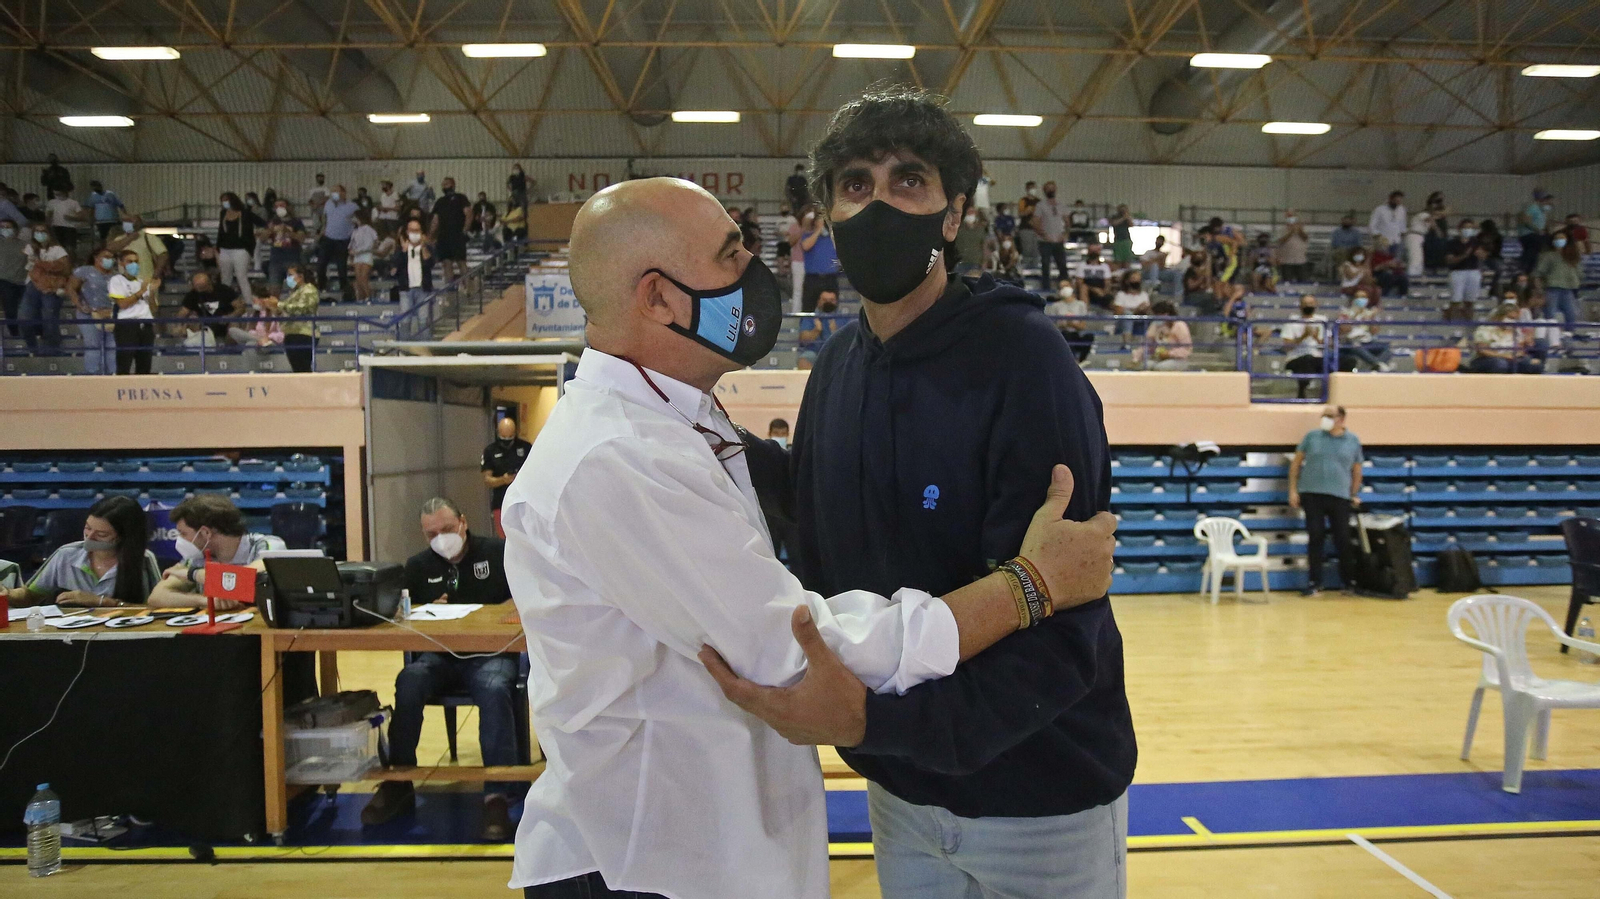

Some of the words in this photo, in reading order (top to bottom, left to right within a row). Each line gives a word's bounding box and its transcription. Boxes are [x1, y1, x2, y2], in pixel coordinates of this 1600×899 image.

[568, 172, 610, 192] NO
[560, 286, 575, 296] De
[557, 299, 570, 309] de
[572, 299, 581, 308] D
[532, 323, 585, 333] Ayuntamien
[726, 306, 741, 342] U.L.B.
[117, 388, 184, 401] PRENSA
[717, 383, 739, 395] SA
